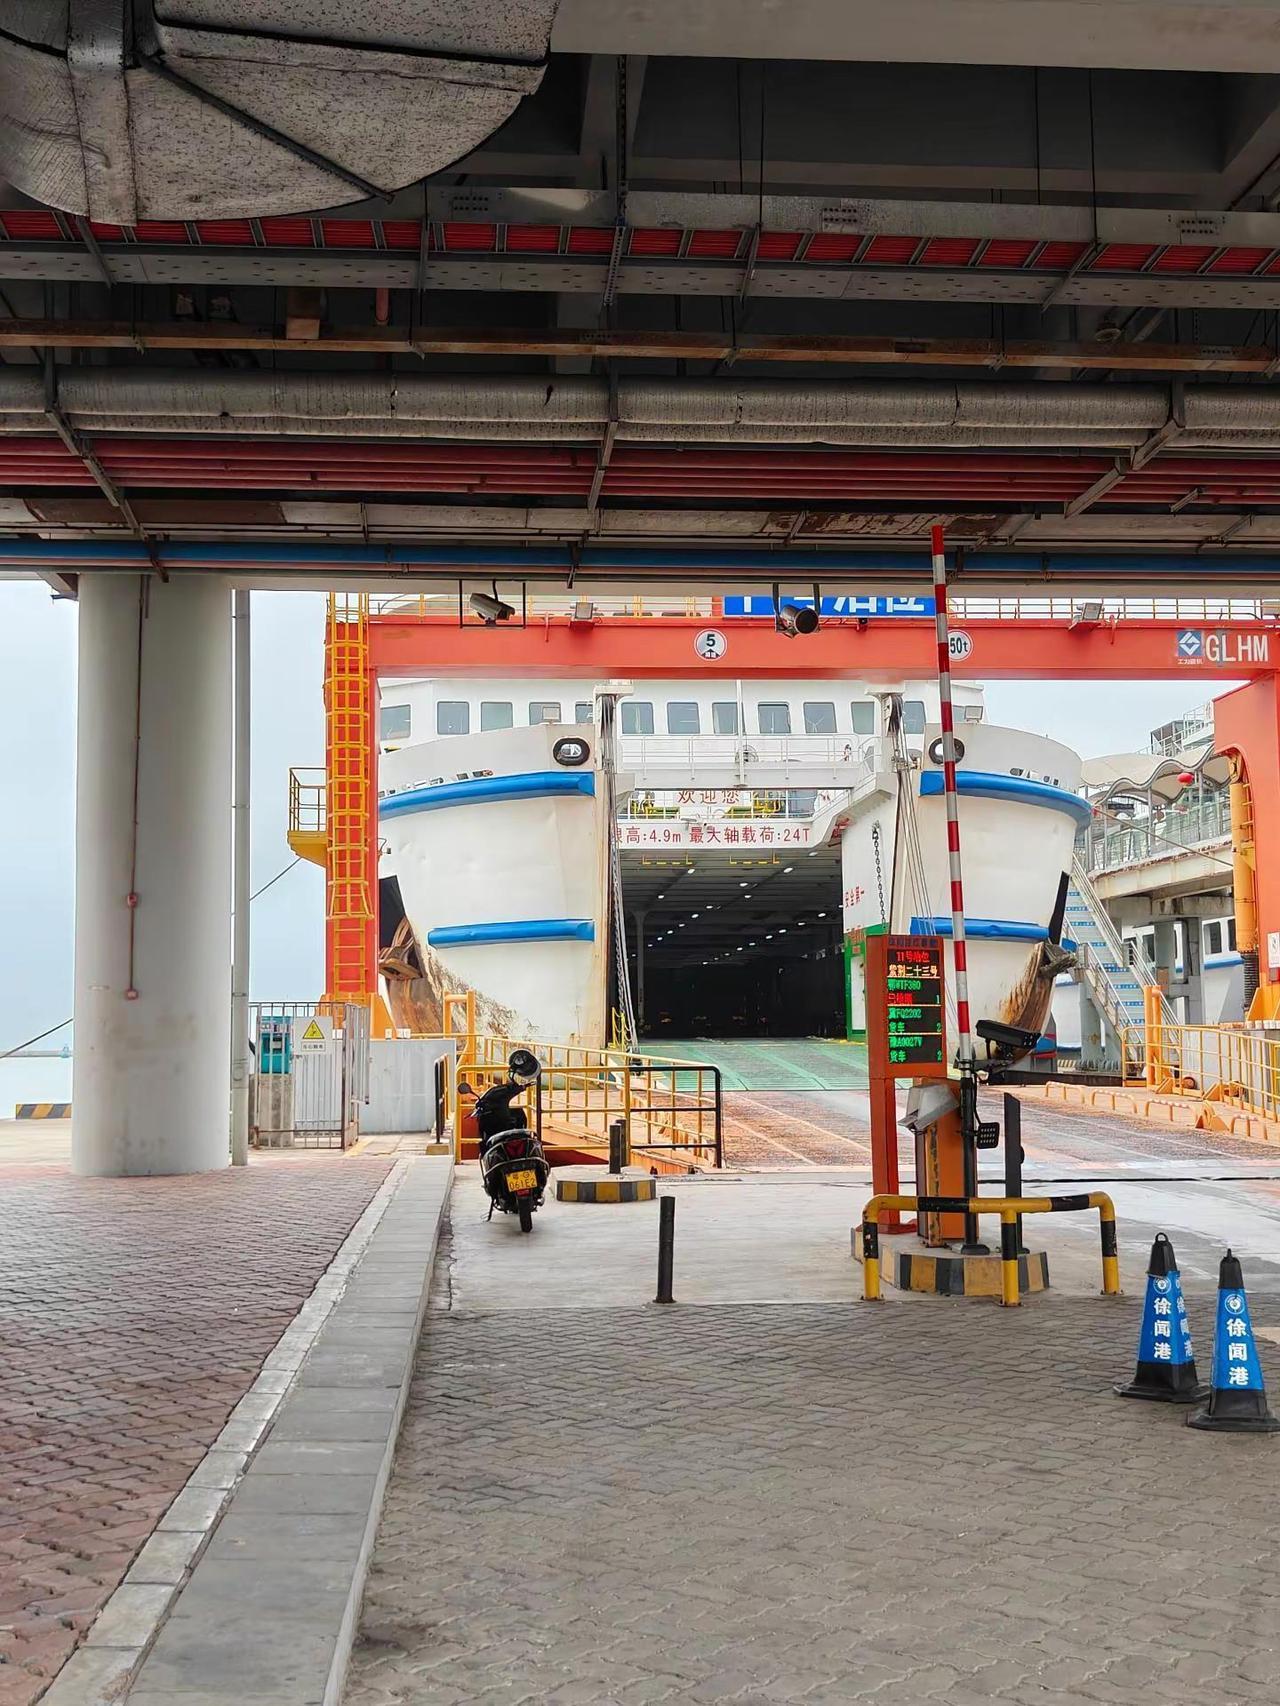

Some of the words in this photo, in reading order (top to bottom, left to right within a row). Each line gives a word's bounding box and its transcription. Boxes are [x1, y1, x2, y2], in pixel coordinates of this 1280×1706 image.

[706, 634, 716, 647] 5
[950, 638, 968, 654] 50t
[1205, 634, 1269, 662] GLHM
[678, 789, 740, 805] 欢迎您
[689, 826, 811, 844] 最大轴载荷:24T
[1153, 1297, 1172, 1360] 徐闻港
[1226, 1318, 1249, 1387] 徐闻港
